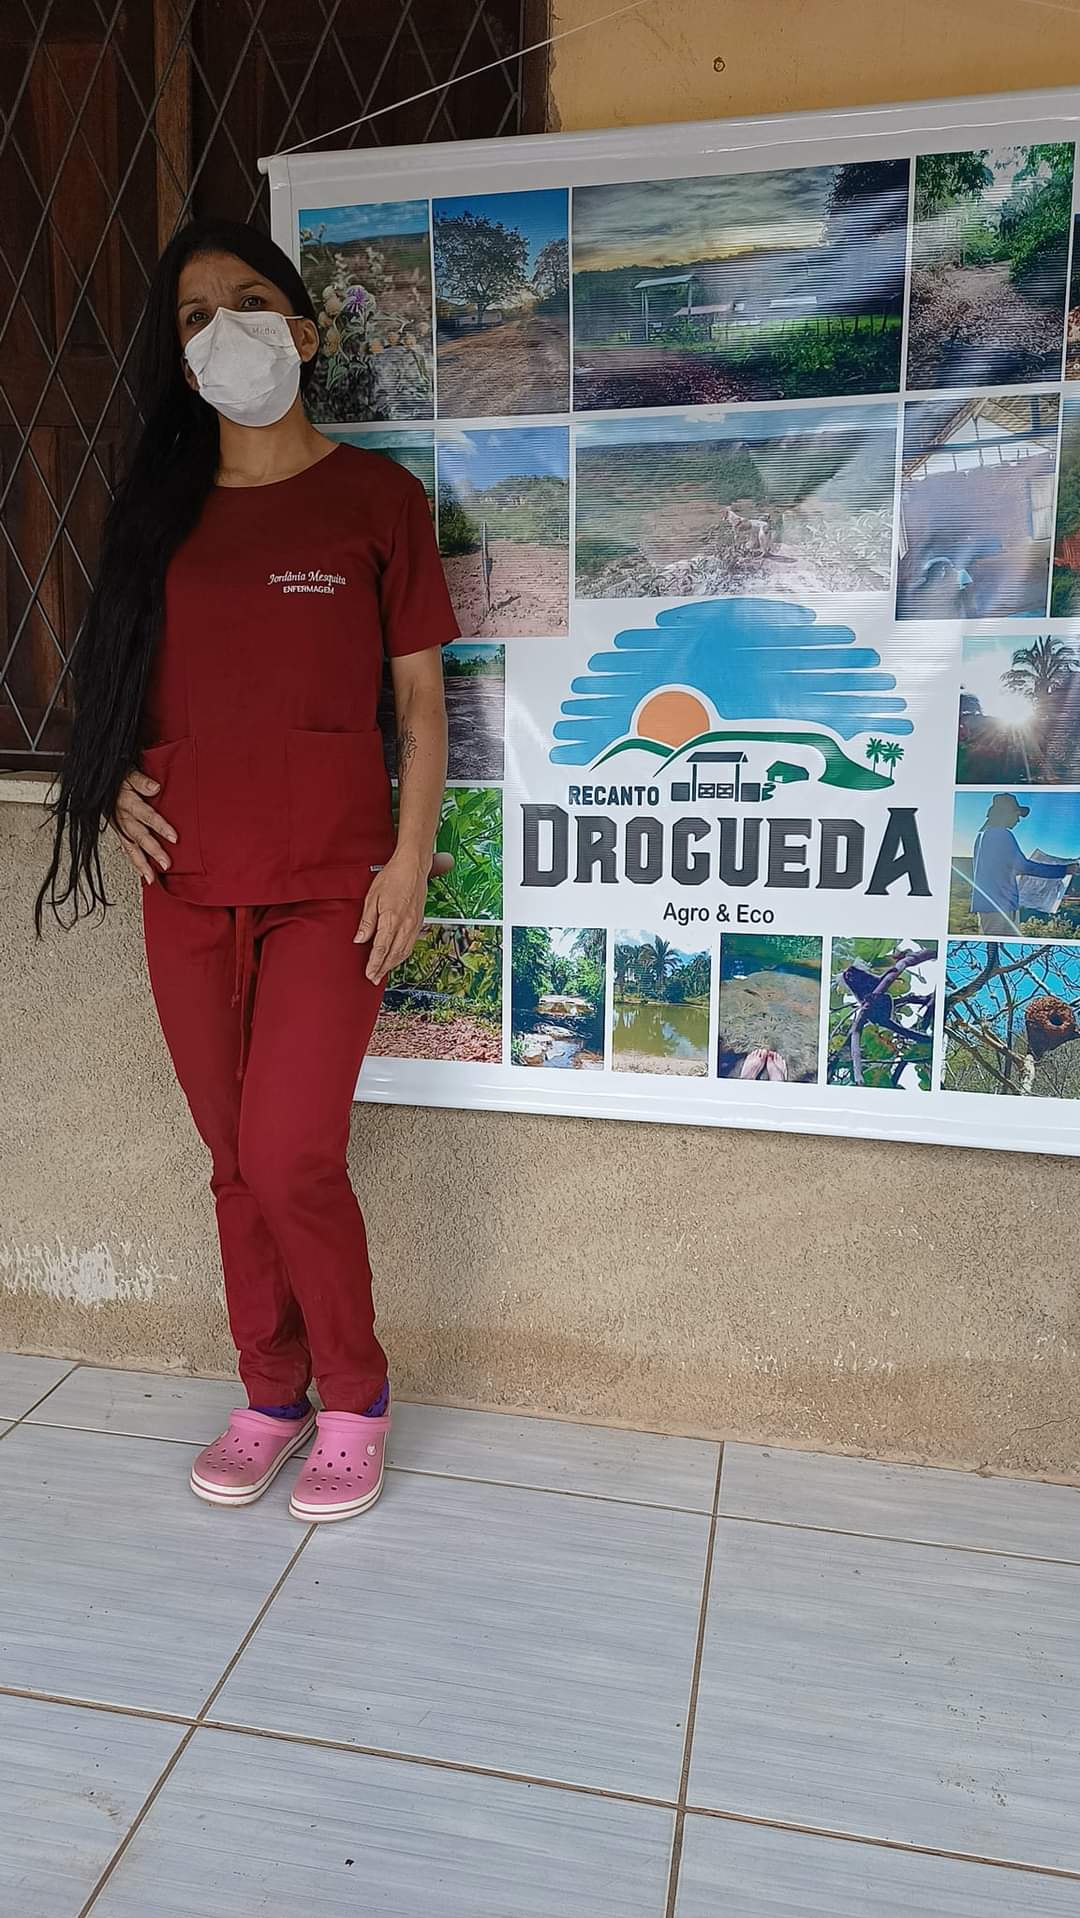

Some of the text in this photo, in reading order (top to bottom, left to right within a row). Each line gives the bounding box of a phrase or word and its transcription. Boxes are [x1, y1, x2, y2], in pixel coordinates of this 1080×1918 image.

[308, 569, 346, 586] Mesquita
[283, 585, 334, 594] ENFERMAGEM
[568, 785, 660, 806] RECANTO
[520, 803, 933, 897] DROGUEDA
[663, 902, 775, 926] Agro & Eco
